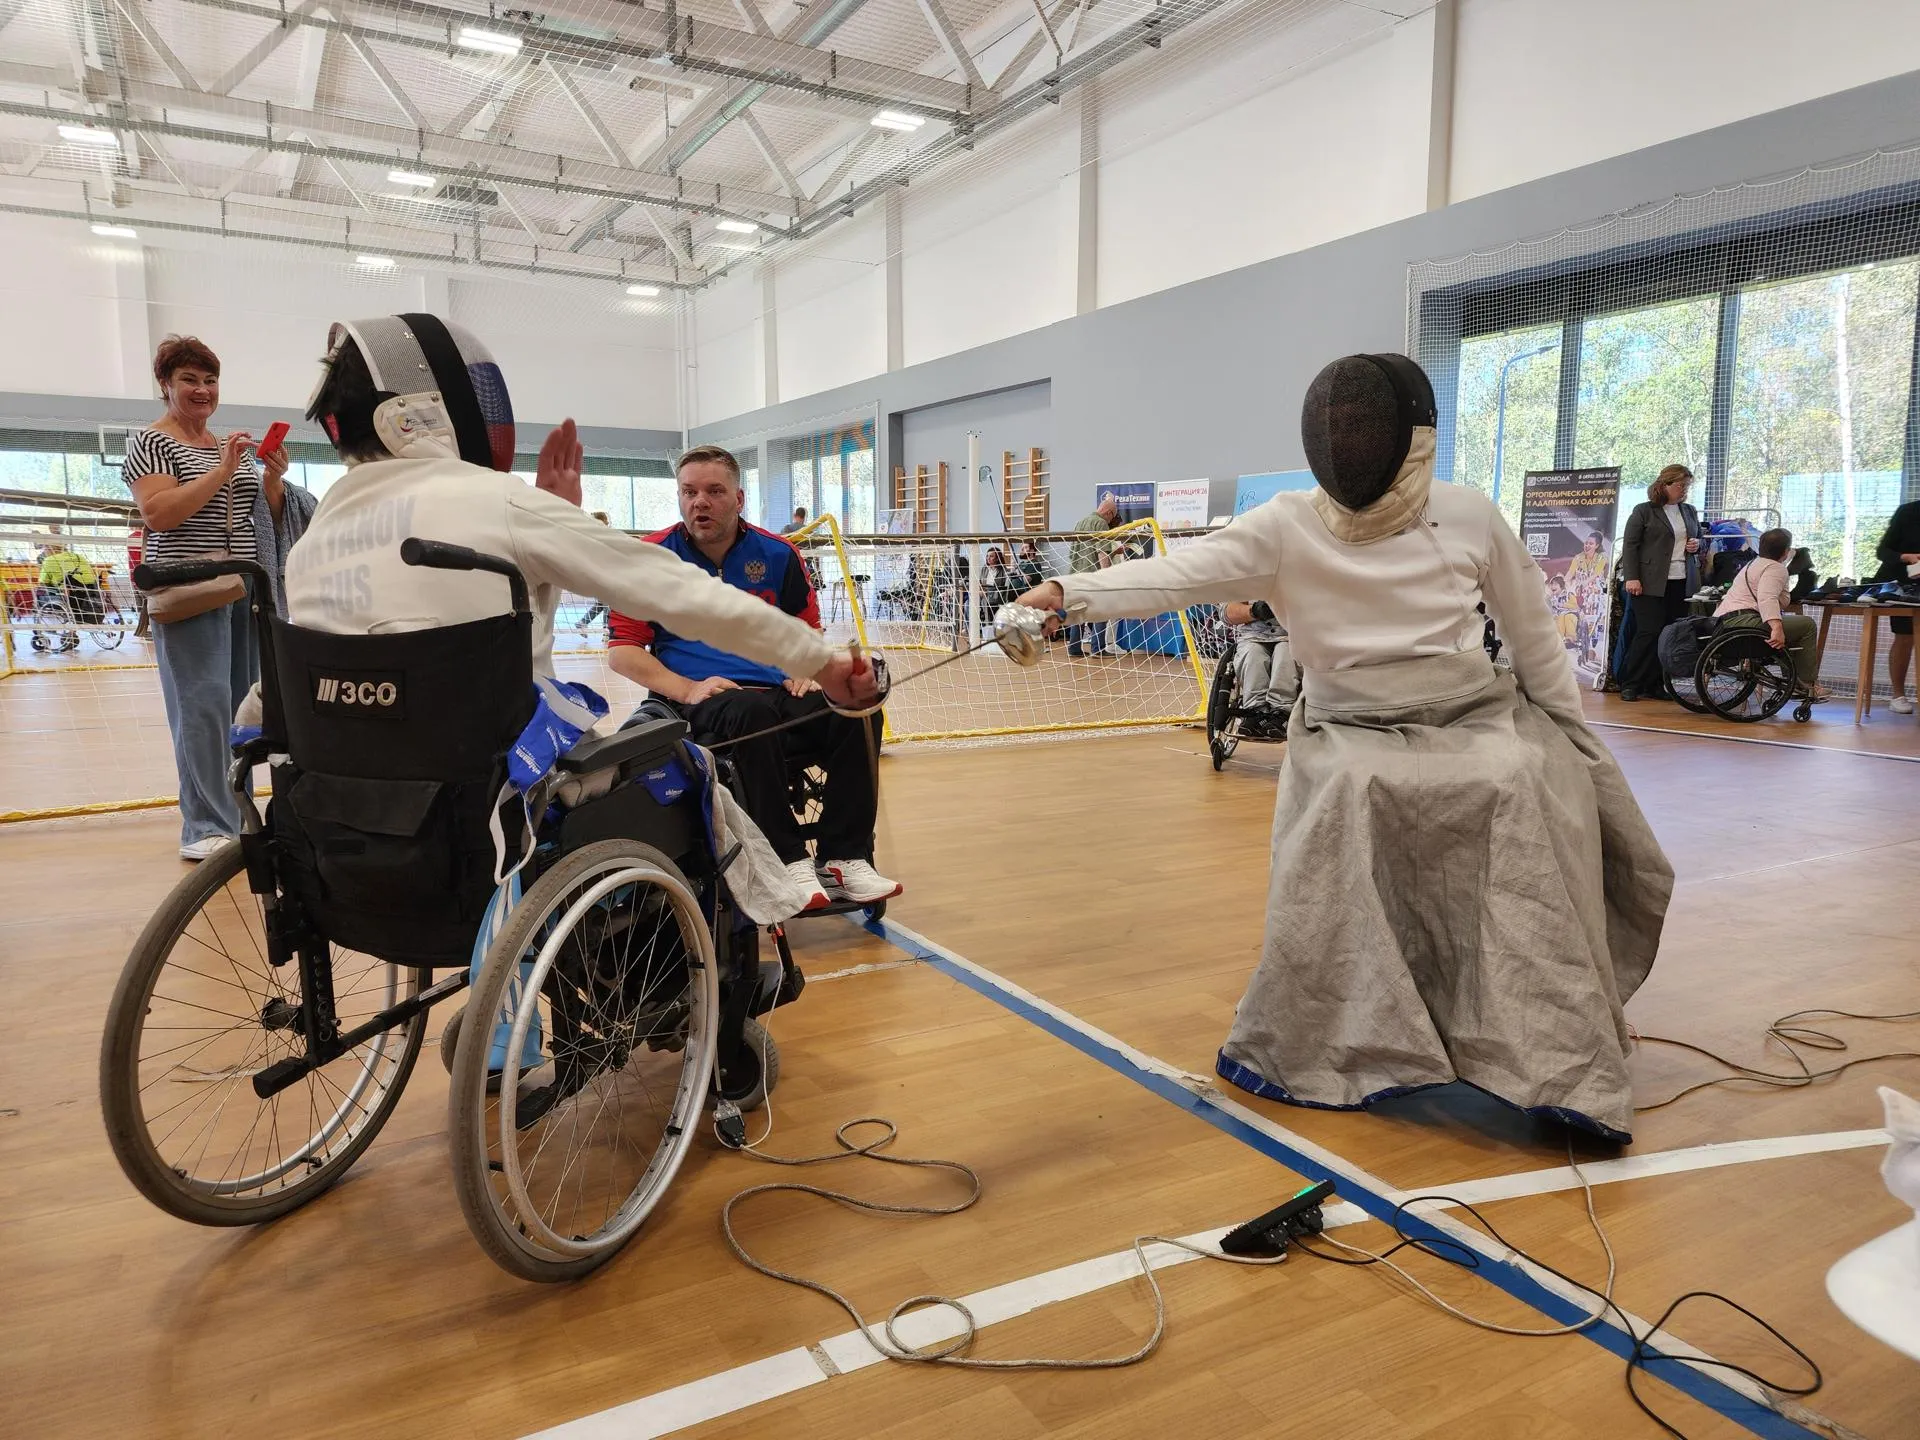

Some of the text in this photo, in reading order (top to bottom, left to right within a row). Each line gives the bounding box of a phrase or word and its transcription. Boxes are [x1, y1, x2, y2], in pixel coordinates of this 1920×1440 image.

[1525, 488, 1617, 499] ОРТОПЕДИЧЕСКАЯ ОБУВЬ
[1532, 499, 1579, 507] АДАПТИВНАЯ
[1580, 497, 1615, 506] ОДЕЖДА
[319, 564, 373, 620] RUS
